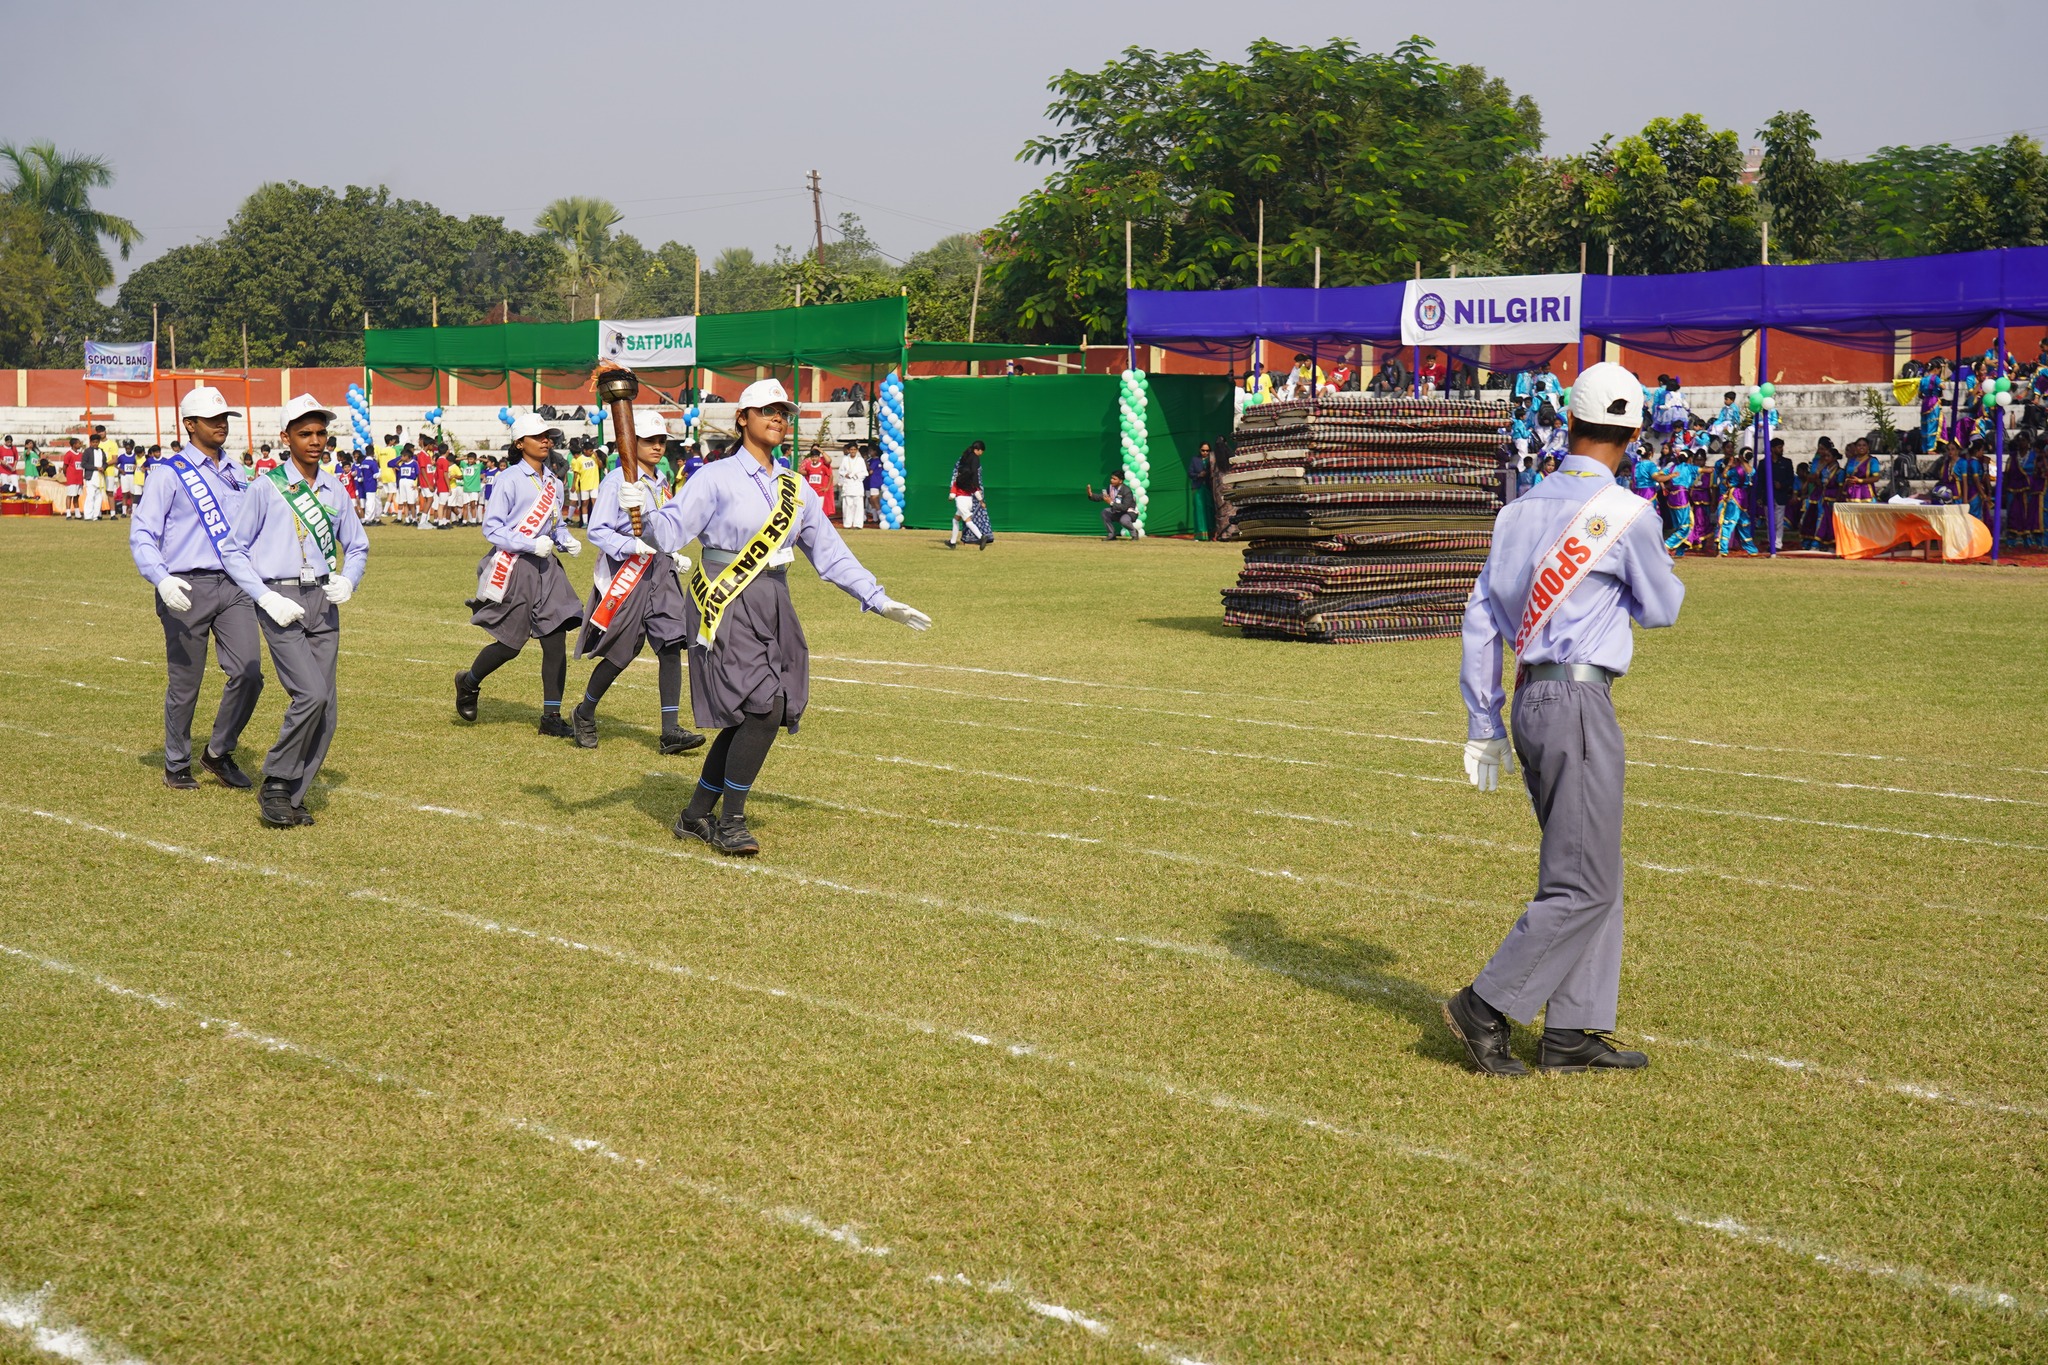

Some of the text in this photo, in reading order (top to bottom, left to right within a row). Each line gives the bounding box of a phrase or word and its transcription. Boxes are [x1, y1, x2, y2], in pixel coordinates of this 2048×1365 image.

[626, 332, 693, 351] SATPURA
[1454, 296, 1571, 324] NILGIRI
[88, 355, 148, 366] SCHOOL BAND
[181, 469, 227, 537] HOUSE
[292, 492, 334, 560] HOUSE
[526, 481, 556, 528] SPORTS
[763, 477, 797, 543] HOUSE
[704, 540, 770, 629] CAPTAIN
[1523, 536, 1591, 639] SPORTS
